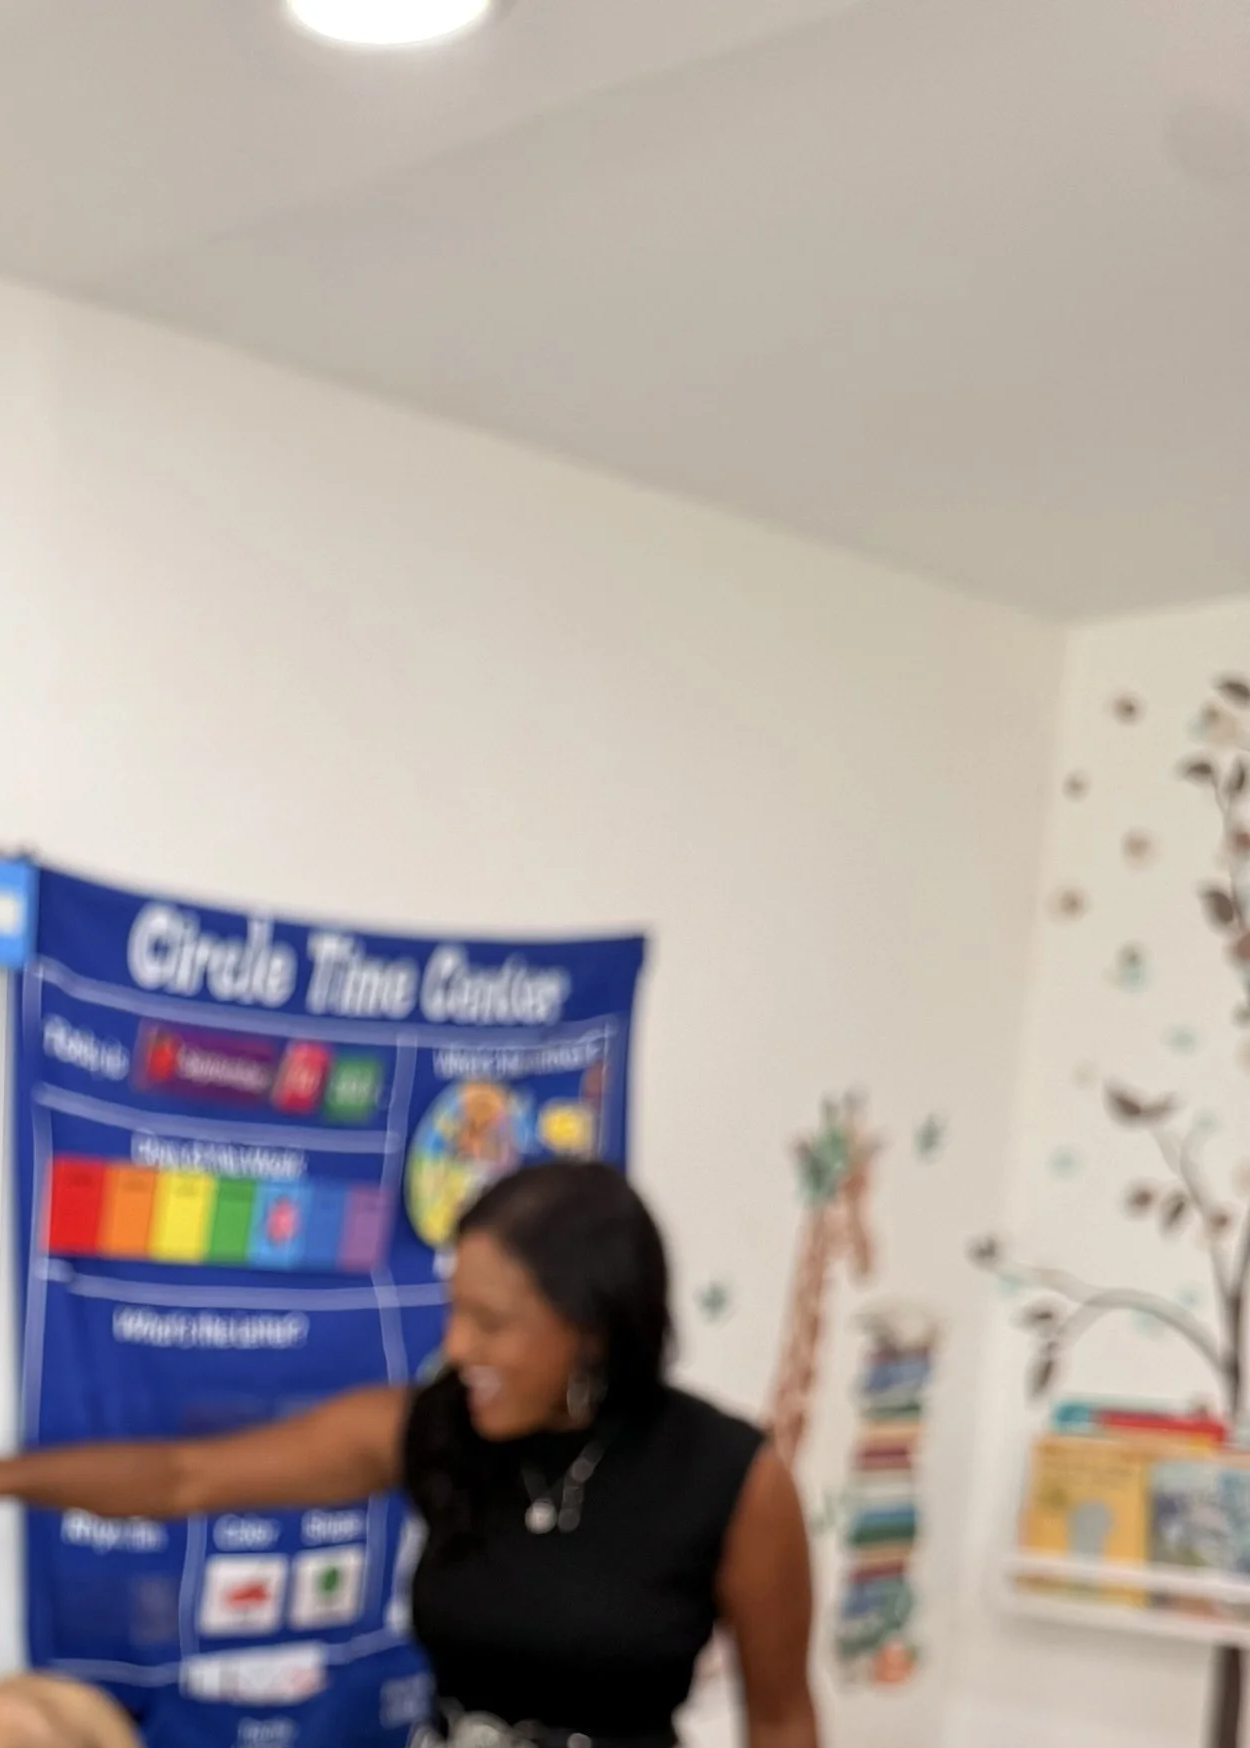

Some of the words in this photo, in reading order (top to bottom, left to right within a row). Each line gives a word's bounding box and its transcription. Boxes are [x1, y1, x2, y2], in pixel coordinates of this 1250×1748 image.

[130, 905, 296, 1004] Circle
[308, 930, 417, 1018] Time
[423, 946, 568, 1024] Center
